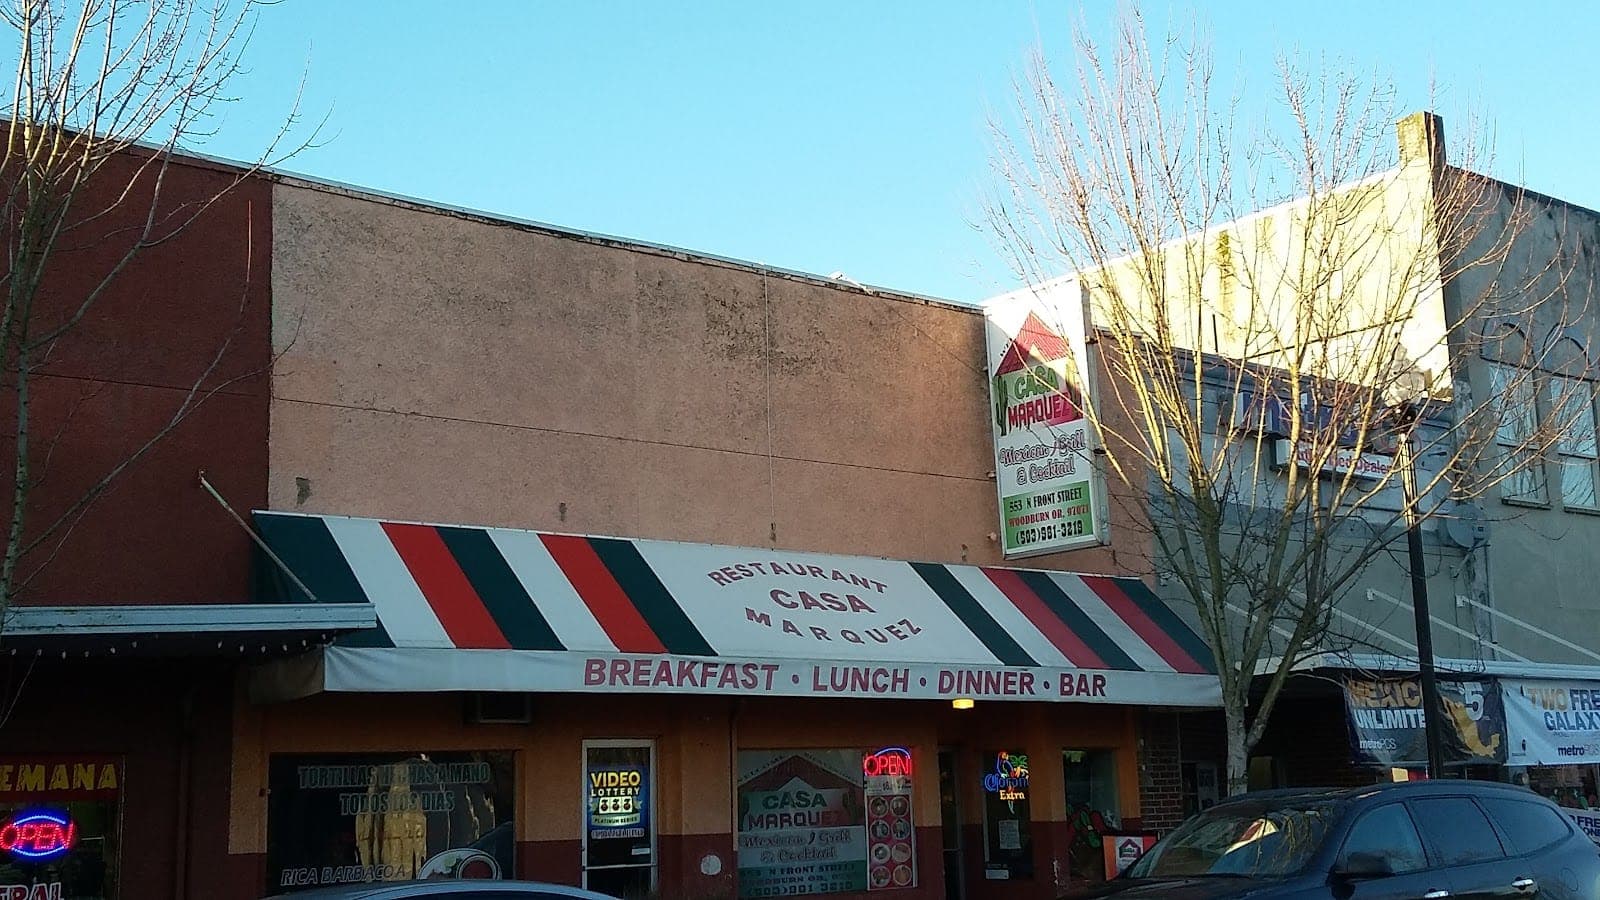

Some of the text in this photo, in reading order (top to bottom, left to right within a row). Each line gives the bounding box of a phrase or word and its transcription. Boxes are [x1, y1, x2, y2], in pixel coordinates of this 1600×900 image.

[1014, 366, 1059, 399] CASA
[1008, 393, 1071, 431] MARQUEZ
[1000, 445, 1049, 466] Mexican
[1059, 429, 1086, 456] Grill
[1029, 454, 1075, 483] Cocktail
[1010, 488, 1082, 512] 553 N FRONT STREET
[1009, 511, 1050, 527] WOODBURN
[708, 561, 888, 594] RESTAURANT
[770, 589, 877, 613] CASA
[745, 607, 922, 644] MARQUEZ
[584, 659, 1107, 696] BREAKFAST LUNCH DINNER BAR
[1350, 681, 1423, 708] MEXIC
[1527, 688, 1569, 711] TWO
[1354, 708, 1426, 729] UNLIMITE
[1359, 738, 1396, 750] metroPCS
[297, 765, 378, 788] TORTILLAS
[449, 762, 491, 784] MANO
[864, 755, 912, 776] OPEN
[590, 771, 641, 787] VIDEO
[340, 791, 455, 815] TODOS LOS DIAS
[591, 787, 640, 797] LOTTERY
[762, 791, 828, 810] CASA
[999, 790, 1025, 800] Extra
[0, 822, 74, 849] OPEN
[280, 864, 405, 886] RICA BARBACOA
[781, 866, 815, 875] FRONT
